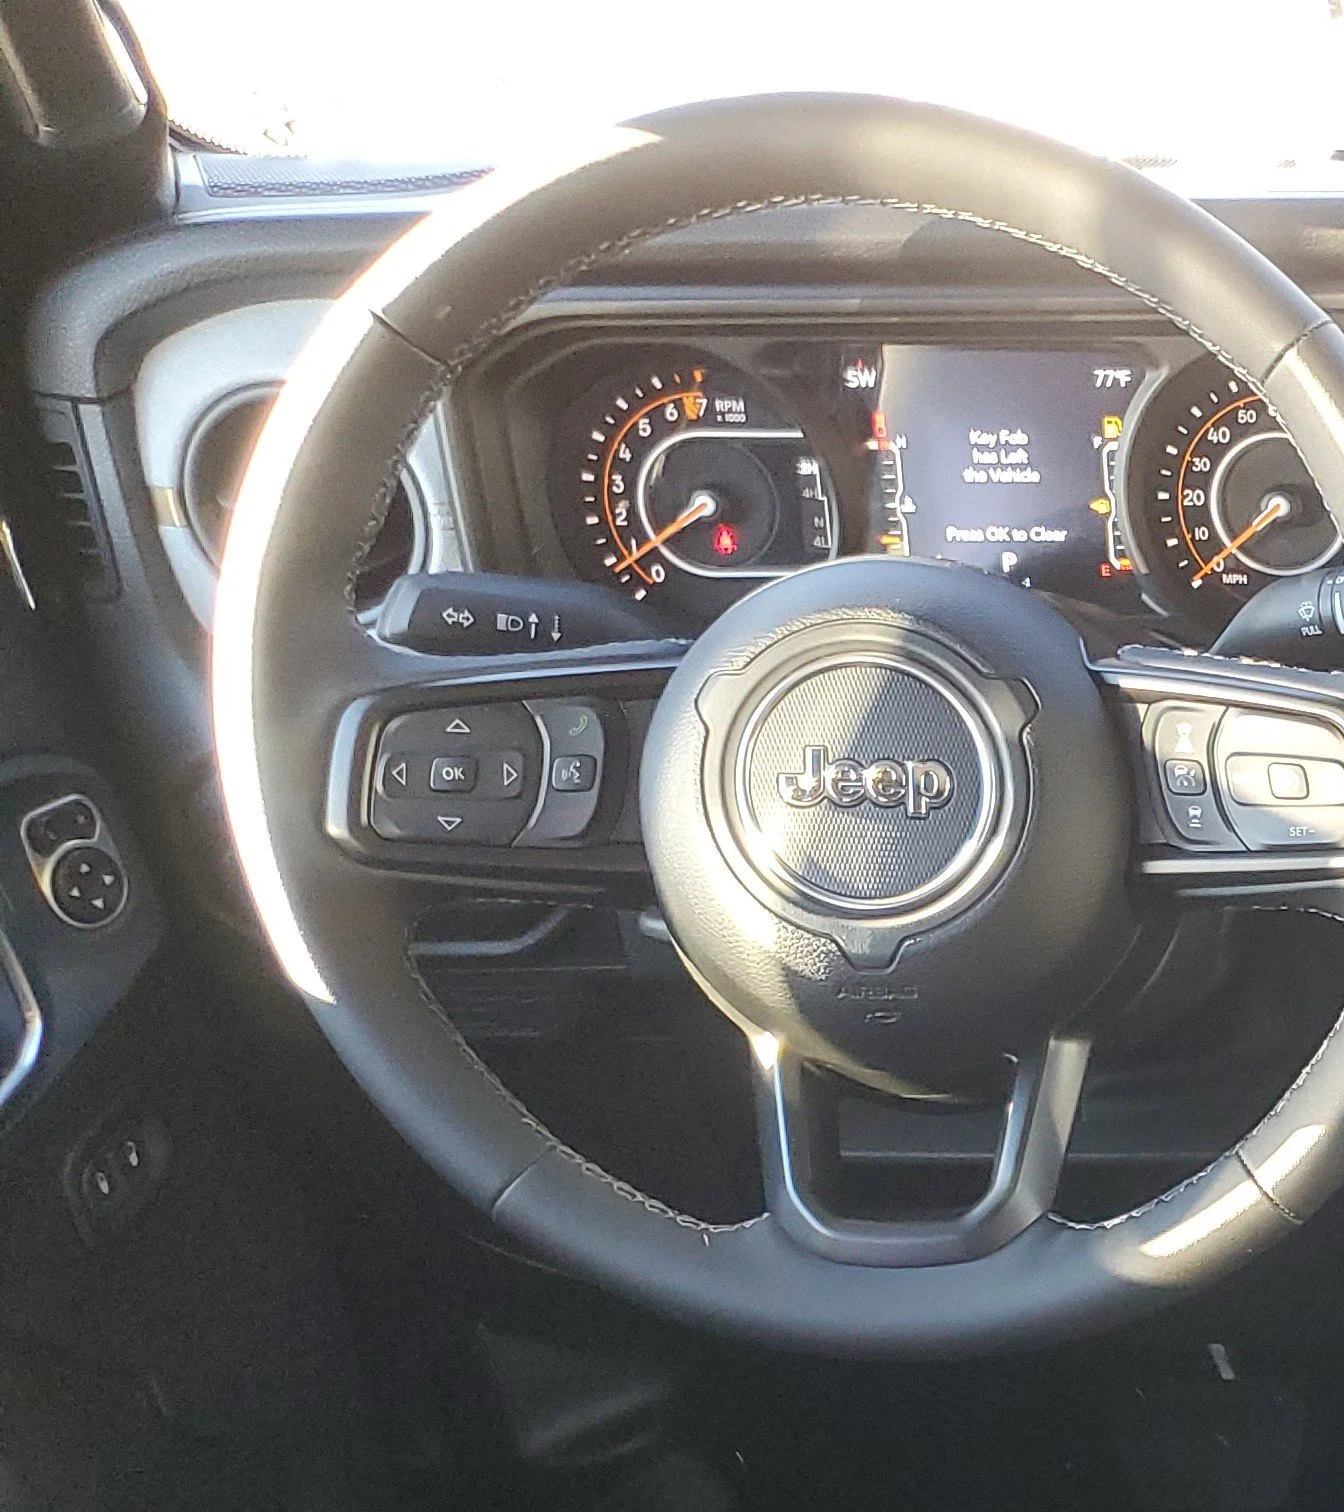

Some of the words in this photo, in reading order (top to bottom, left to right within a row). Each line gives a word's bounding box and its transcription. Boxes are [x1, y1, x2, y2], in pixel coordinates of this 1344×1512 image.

[844, 369, 877, 389] SW
[665, 402, 679, 422] 6
[695, 398, 708, 417] 7
[715, 397, 745, 412] RPM
[1237, 409, 1257, 424] 50
[638, 418, 652, 438] 5
[1207, 426, 1231, 443] 40
[968, 428, 998, 448] Key
[619, 443, 632, 463] 4
[988, 465, 1041, 483] Vehicle
[1192, 458, 1211, 472] 30
[611, 474, 625, 494] 3
[1183, 489, 1205, 506] 20
[615, 506, 628, 527] 2
[945, 525, 985, 542] Press
[985, 525, 1010, 542] OK
[1011, 528, 1028, 541] to
[1029, 526, 1068, 541] Clear
[1194, 527, 1209, 542] 10
[1002, 551, 1018, 573] P
[1101, 562, 1112, 577] E
[1213, 556, 1225, 573] 0
[650, 562, 666, 583] 0
[1222, 573, 1248, 585] MPH
[442, 767, 465, 780] OK
[777, 744, 955, 819] Jeep
